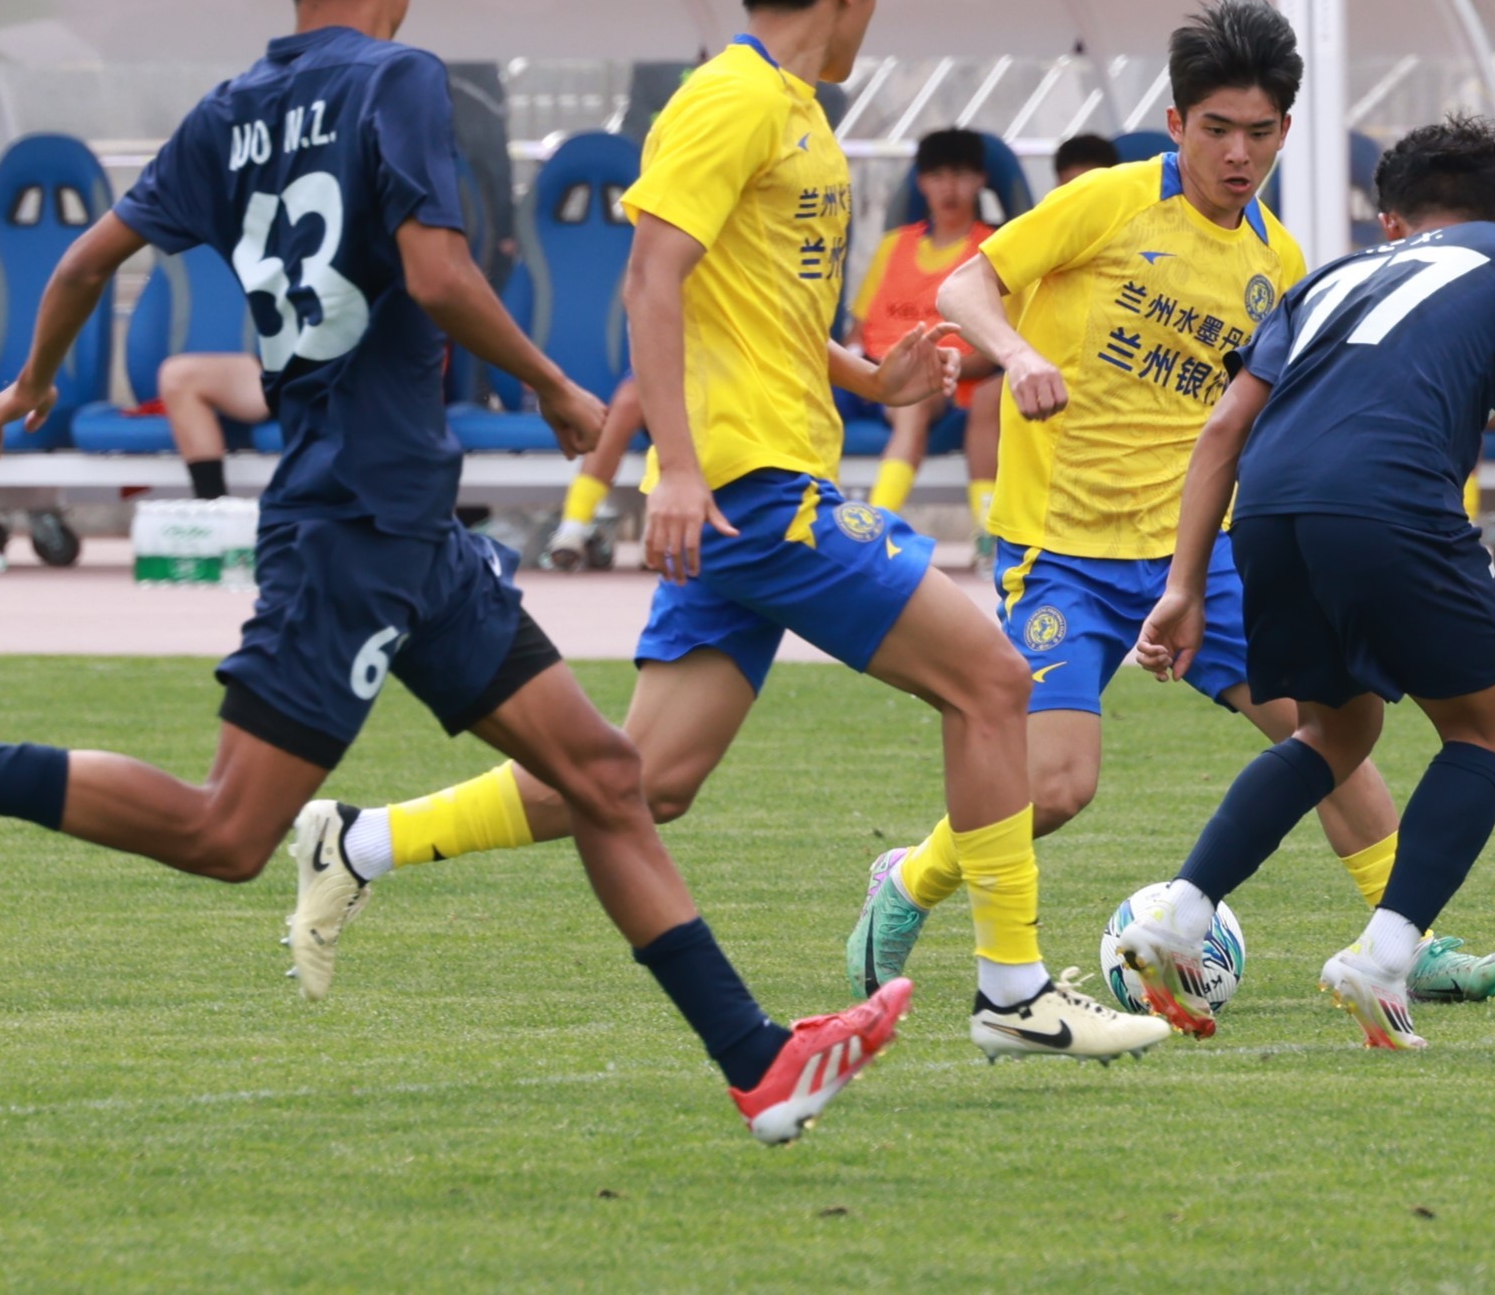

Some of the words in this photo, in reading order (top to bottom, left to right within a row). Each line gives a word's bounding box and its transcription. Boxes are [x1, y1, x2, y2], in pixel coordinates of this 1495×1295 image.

[232, 171, 369, 372] 63
[1114, 280, 1251, 351] 兰州水墨丹
[1288, 245, 1491, 365] 77
[350, 624, 411, 701] 6
